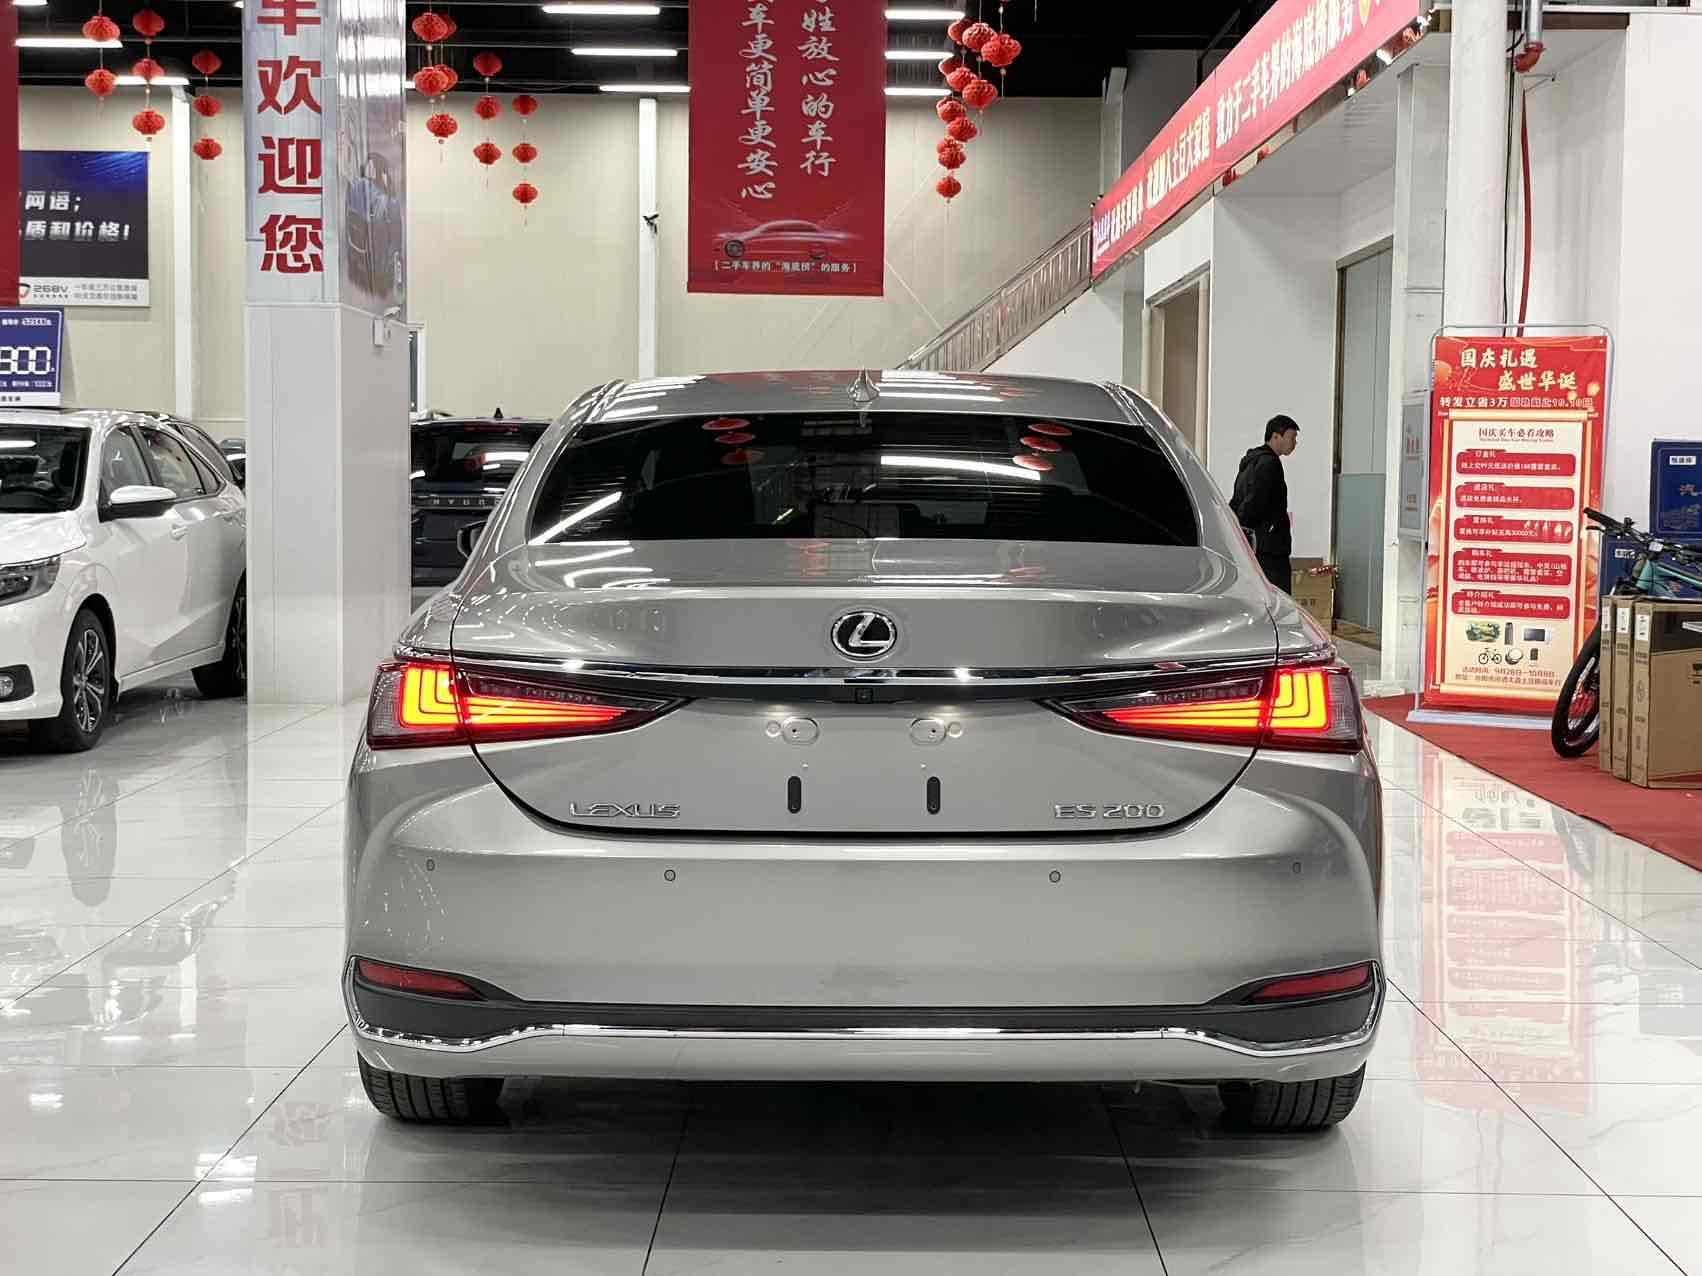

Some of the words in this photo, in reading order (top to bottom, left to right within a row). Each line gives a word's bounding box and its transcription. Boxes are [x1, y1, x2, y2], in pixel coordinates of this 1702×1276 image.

[797, 0, 841, 177] 姓放心的车行
[738, 0, 779, 200] 车更简单更安心
[19, 220, 130, 242] 质和价格！
[1461, 347, 1538, 369] 国庆礼遇
[1498, 370, 1578, 392] 盛世华诞
[569, 802, 681, 819] LEXUS
[1055, 804, 1098, 819] ES
[1103, 804, 1166, 819] 200
